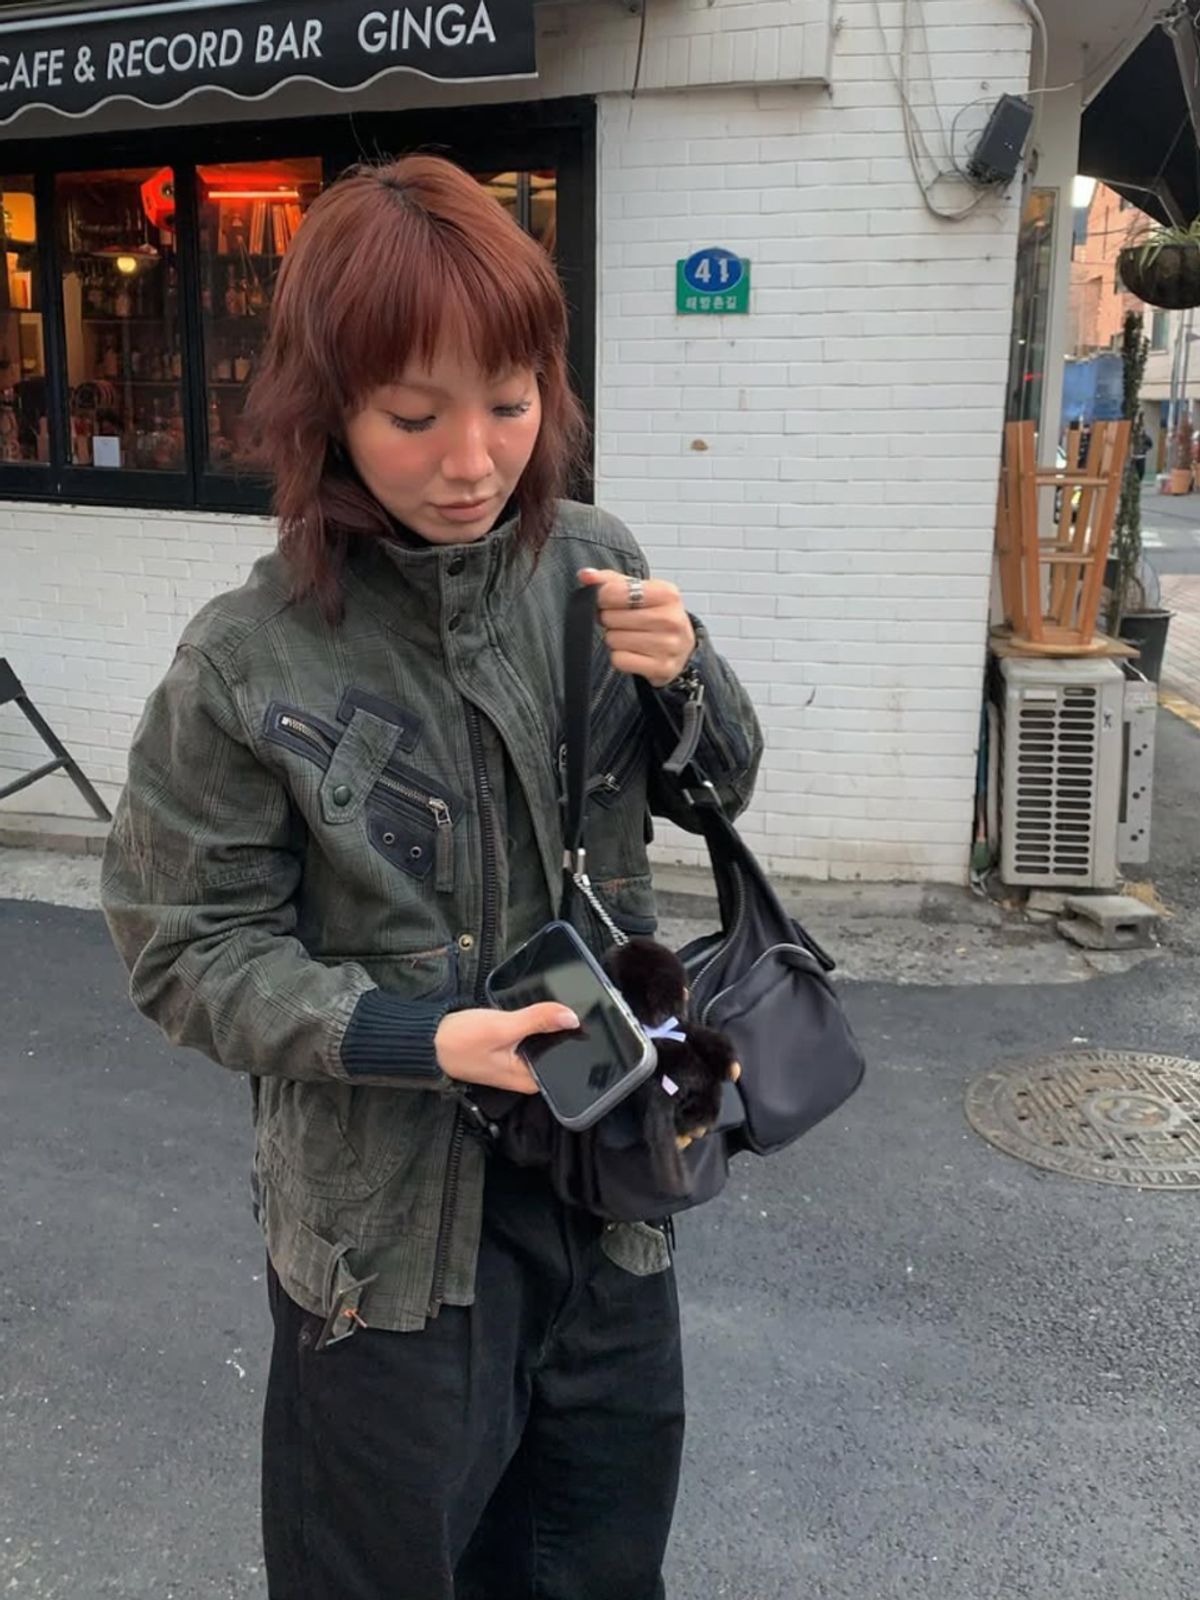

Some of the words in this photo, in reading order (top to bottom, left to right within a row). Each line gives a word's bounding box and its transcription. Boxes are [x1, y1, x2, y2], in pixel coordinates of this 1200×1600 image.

[73, 45, 96, 84] &
[106, 28, 243, 80] RECORD
[255, 18, 323, 63] BAR
[357, 0, 497, 54] GINGA
[694, 258, 730, 283] 41
